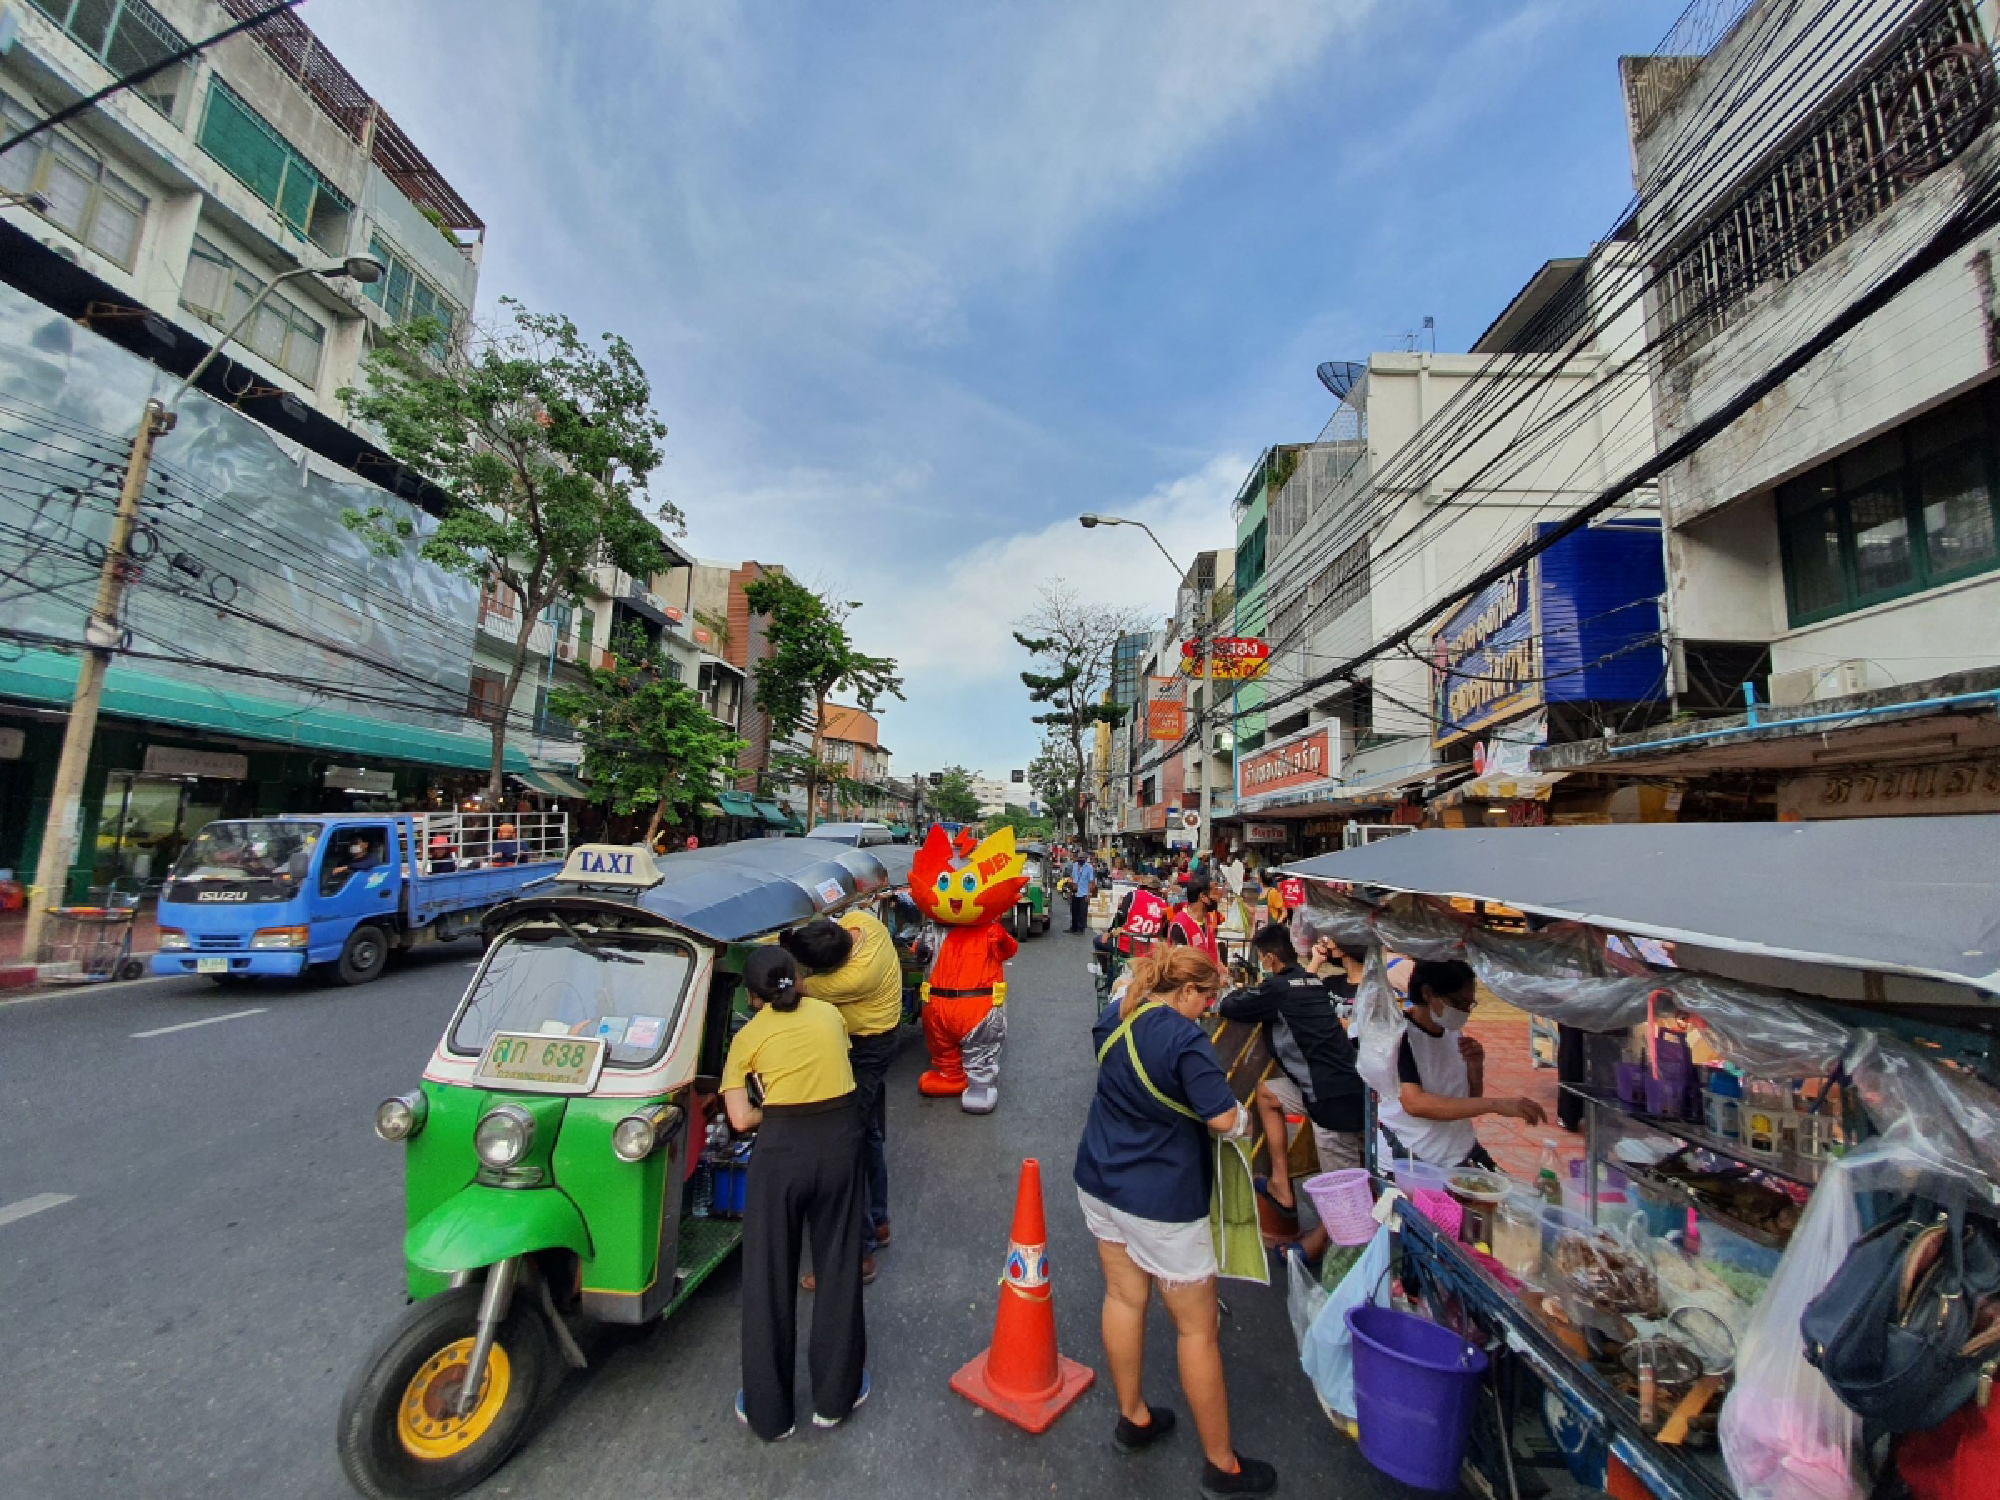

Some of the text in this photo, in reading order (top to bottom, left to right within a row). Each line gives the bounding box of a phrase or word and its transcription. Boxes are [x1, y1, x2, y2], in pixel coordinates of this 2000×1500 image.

[577, 851, 634, 874] TAXI
[197, 891, 248, 901] ISUZU
[542, 1042, 586, 1068] 638
